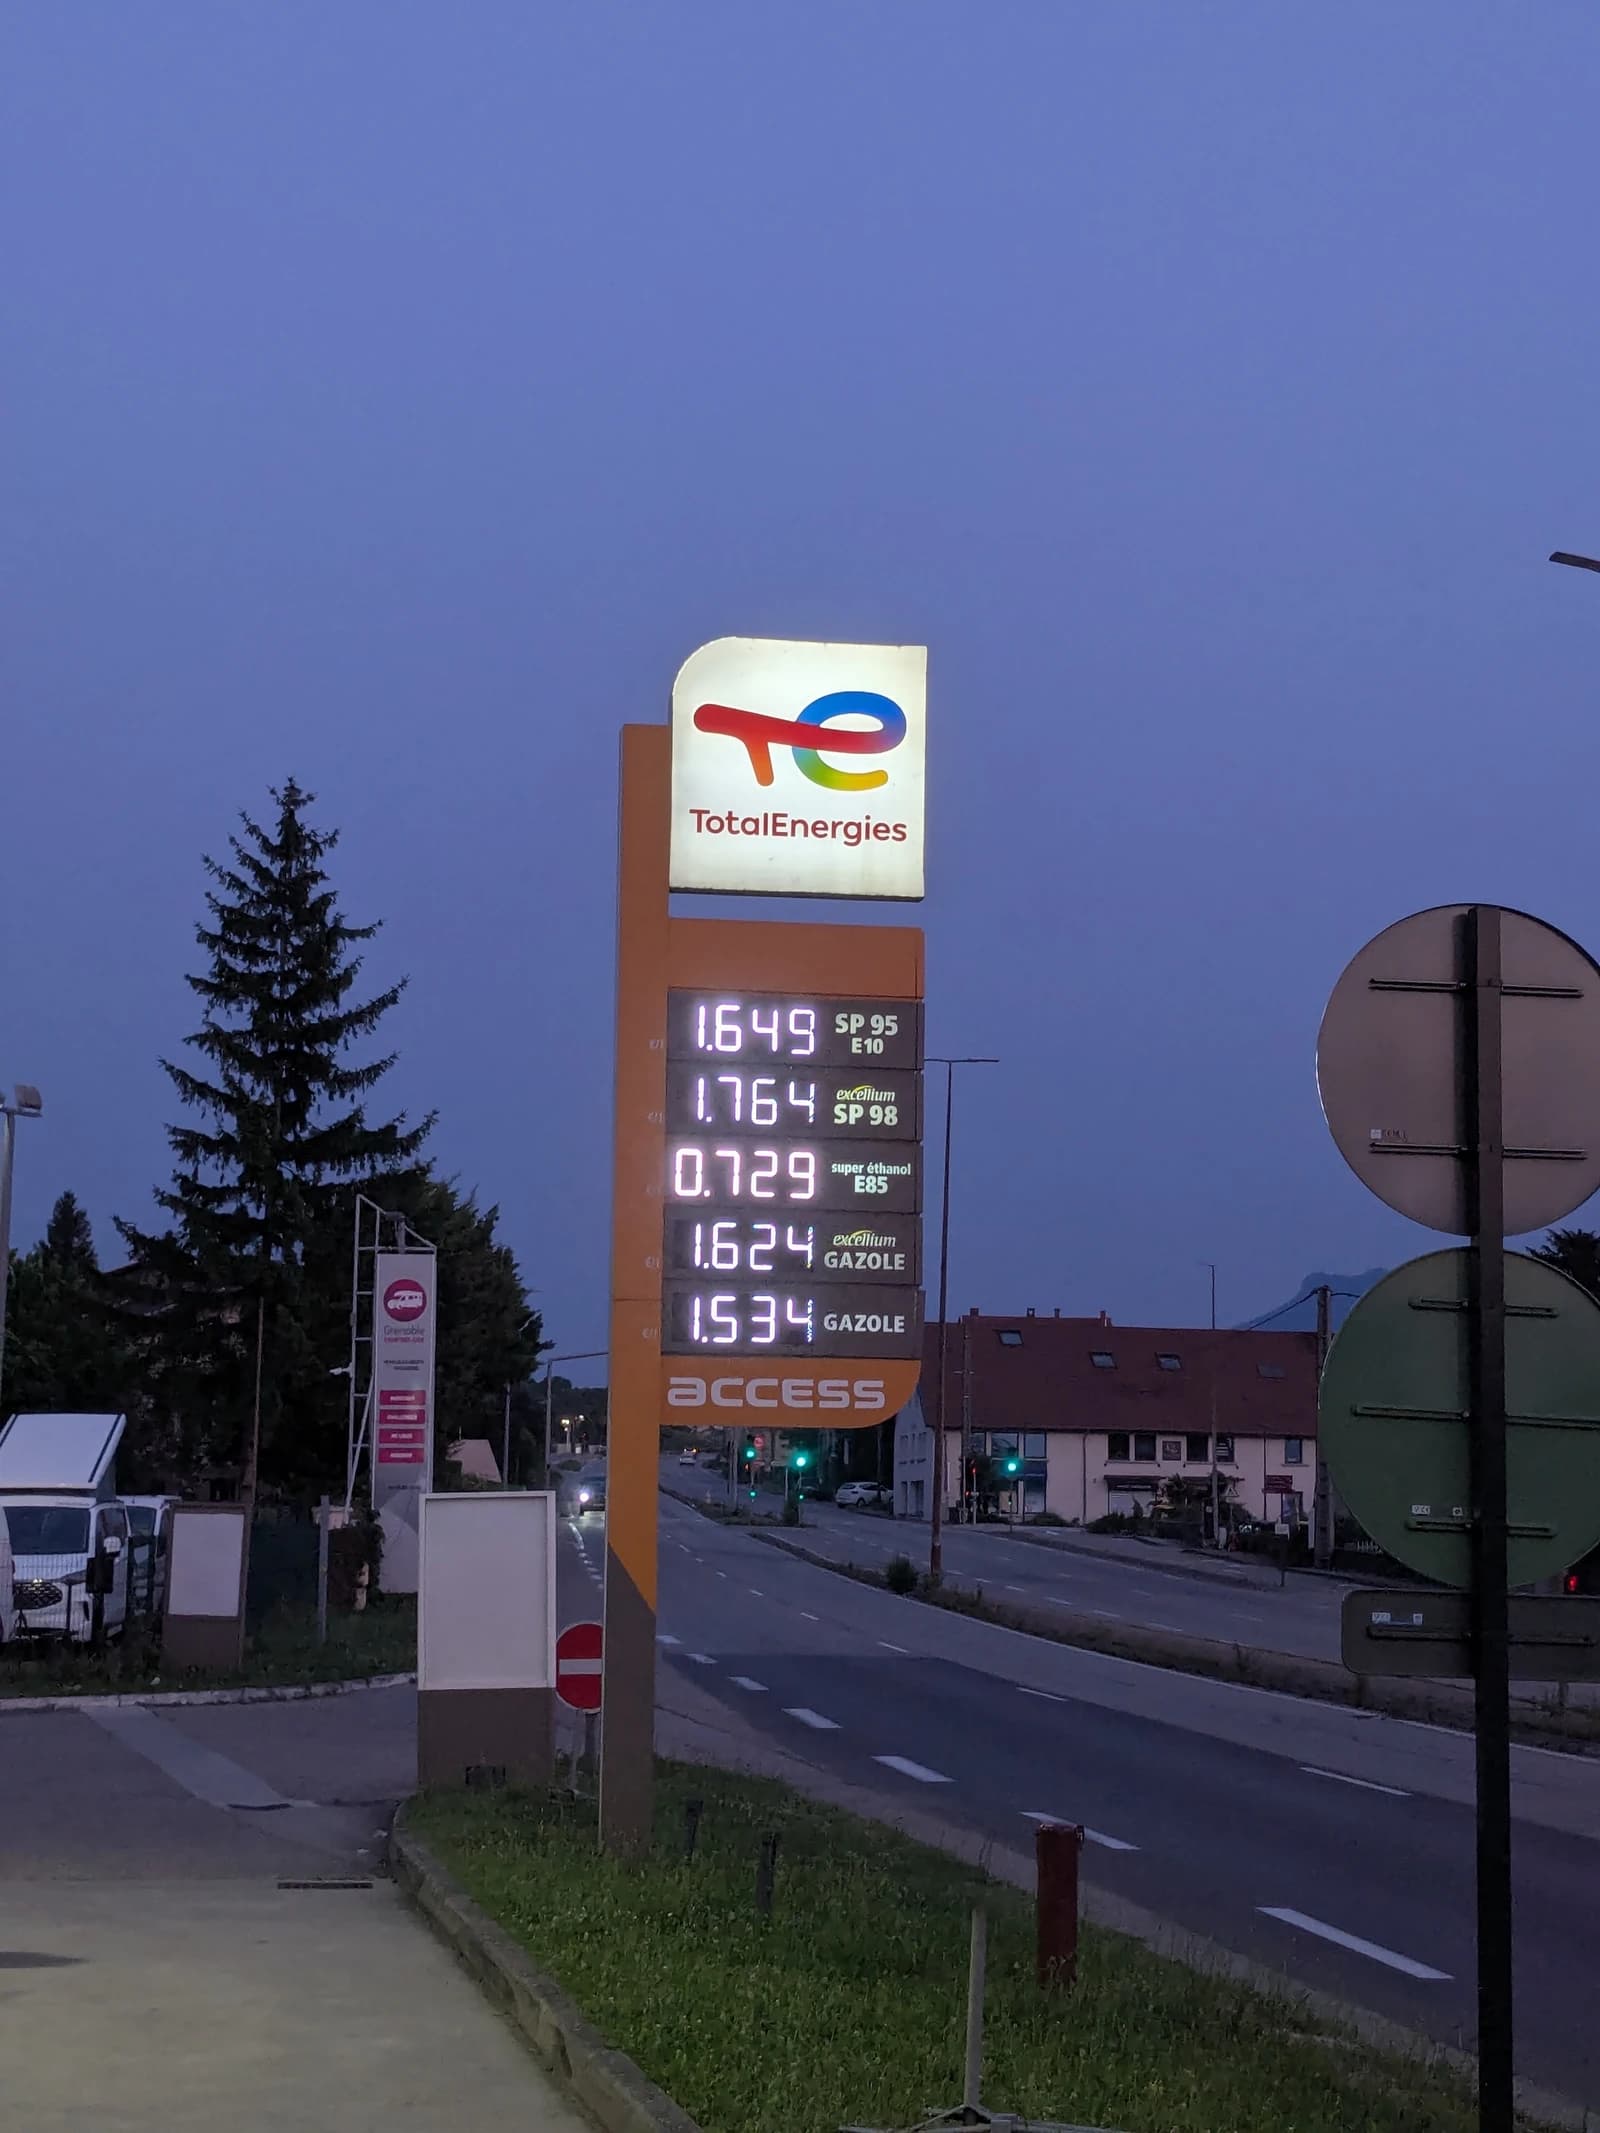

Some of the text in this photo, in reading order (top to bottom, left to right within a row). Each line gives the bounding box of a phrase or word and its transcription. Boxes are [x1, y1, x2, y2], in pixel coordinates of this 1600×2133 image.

[689, 808, 907, 847] TotalEnergies
[698, 1004, 816, 1055] 1.649
[835, 1013, 899, 1036] SP 95
[851, 1037, 884, 1055] E10
[697, 1076, 816, 1125] 1.764
[836, 1085, 896, 1102] excellium
[833, 1103, 898, 1126] SP 98
[674, 1148, 816, 1200] 0.729
[831, 1161, 911, 1176] super éthanol
[854, 1175, 888, 1194] E85
[694, 1222, 813, 1271] 1.624
[833, 1230, 896, 1248] excellium
[824, 1251, 905, 1271] GAZOLE
[693, 1295, 813, 1343] 1.534
[823, 1313, 905, 1333] GAZOLE
